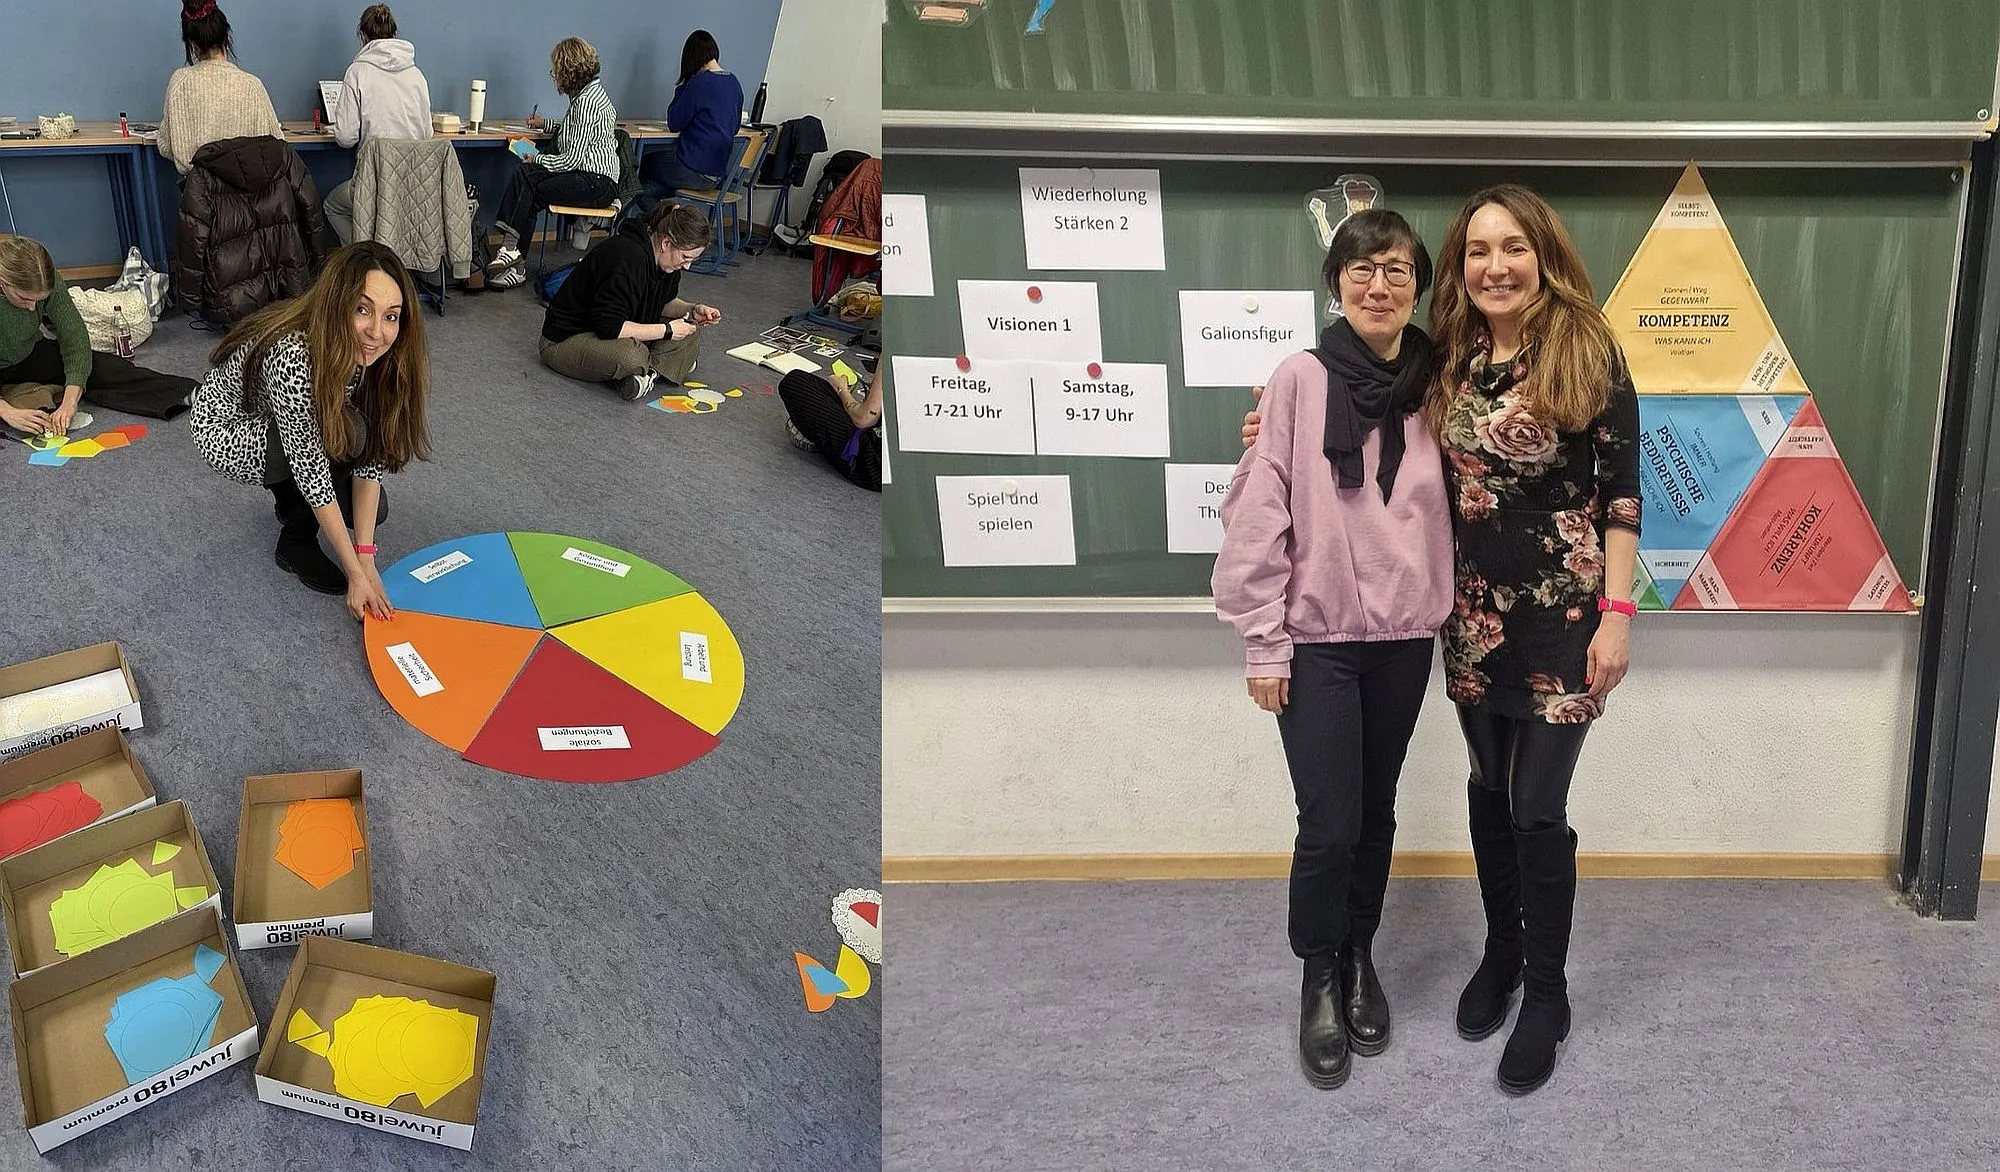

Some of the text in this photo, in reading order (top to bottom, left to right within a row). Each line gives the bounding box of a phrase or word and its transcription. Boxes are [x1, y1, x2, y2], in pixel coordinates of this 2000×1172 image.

[1031, 186, 1147, 205] Wiederholung
[1054, 215, 1129, 231] Stärken 2
[1660, 296, 1710, 305] GEGENWART
[986, 316, 1072, 332] Visionen 1
[1638, 314, 1730, 327] KOMPETENZ
[1201, 325, 1294, 344] Galionsfigur
[1654, 337, 1712, 345] WAS KANN ICH
[931, 375, 992, 394] Freitag,
[1062, 379, 1135, 397] Samstag,
[923, 404, 1003, 419] 17-21 Uhr
[1065, 408, 1135, 422] 9-17 Uhr
[1656, 424, 1705, 504] PSYCHISCHE
[1640, 430, 1691, 517] BEDÜRFNISSE
[967, 491, 1039, 509] Spiel und
[978, 516, 1033, 534] spielen
[1783, 507, 1797, 526] WAS
[1770, 504, 1822, 574] KOHÄRENZ
[1801, 532, 1824, 566] ZUKUNFT
[551, 728, 613, 736] Beziehungen
[0, 737, 48, 756] premium
[568, 739, 602, 747] soziale
[266, 919, 325, 932] premium
[63, 1043, 233, 1130] juwel80 premium
[281, 1089, 446, 1140] juwel80 premium
